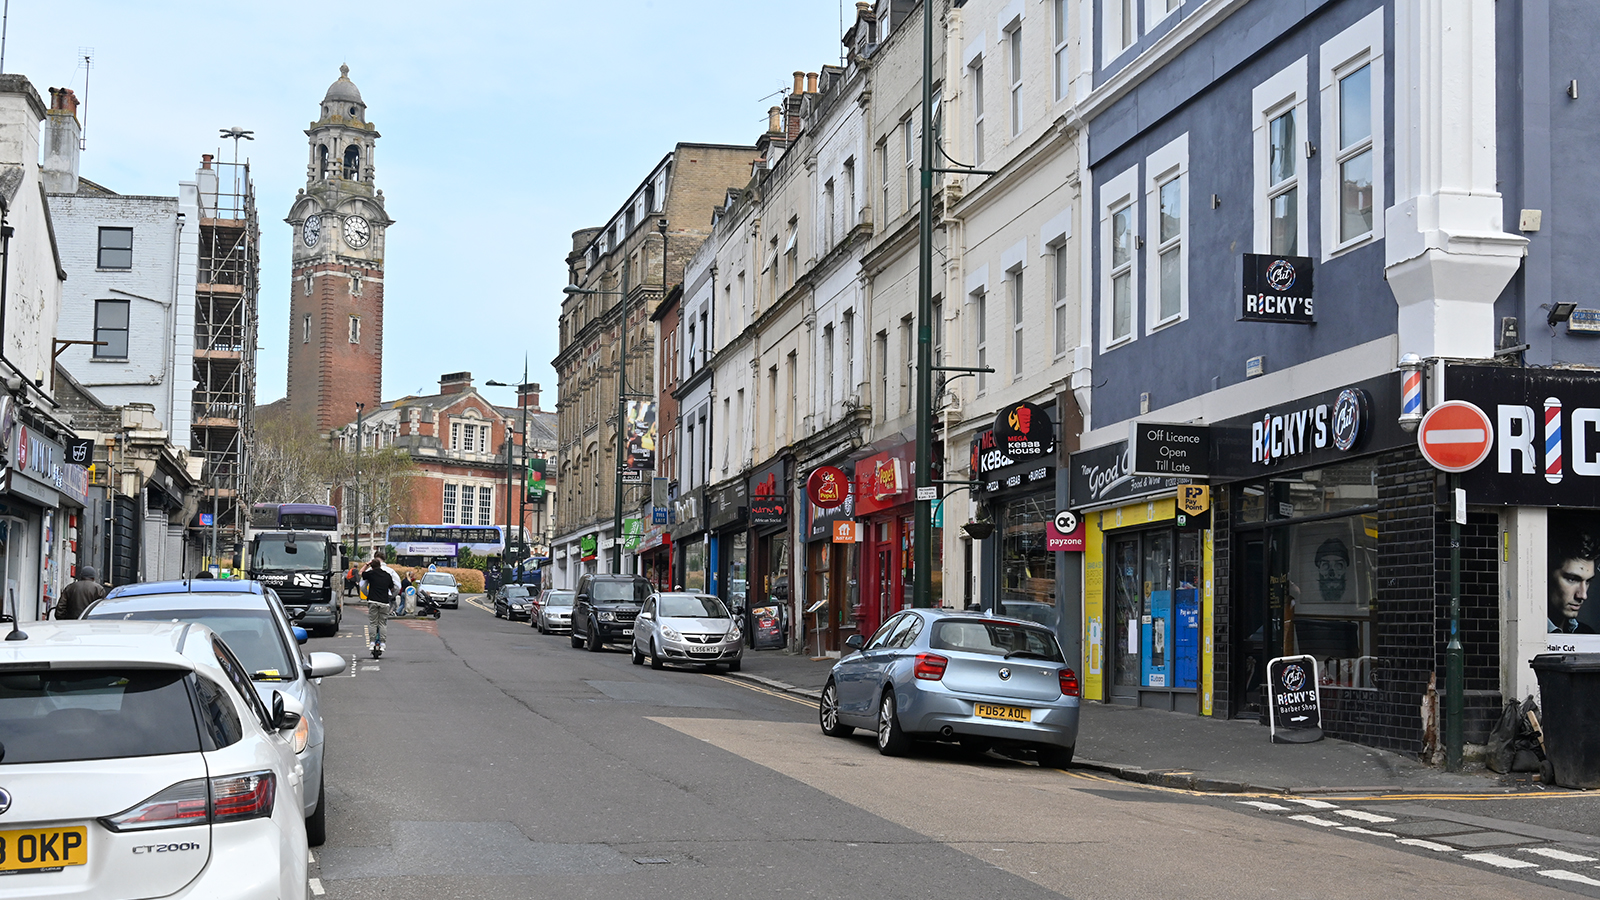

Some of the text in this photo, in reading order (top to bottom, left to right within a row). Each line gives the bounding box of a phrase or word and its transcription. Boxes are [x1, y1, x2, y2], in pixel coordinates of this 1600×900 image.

[1246, 293, 1314, 315] RICKY'S
[1147, 430, 1200, 444] Off Licence
[1251, 404, 1329, 466] RICKY'S
[1160, 446, 1186, 459] Open
[880, 464, 894, 484] Pepe's
[1155, 460, 1191, 473] Till Late
[1008, 474, 1021, 487] KEBAB
[1030, 467, 1047, 481] BURGER
[1089, 455, 1119, 499] Good
[1130, 478, 1143, 491] Food
[1148, 476, 1161, 486] Wine
[1050, 539, 1082, 547] payzone
[1277, 690, 1316, 706] RICKY'S
[979, 705, 1027, 719] FD62 AOL
[1280, 705, 1300, 713] Barber
[18, 832, 82, 863] OKP
